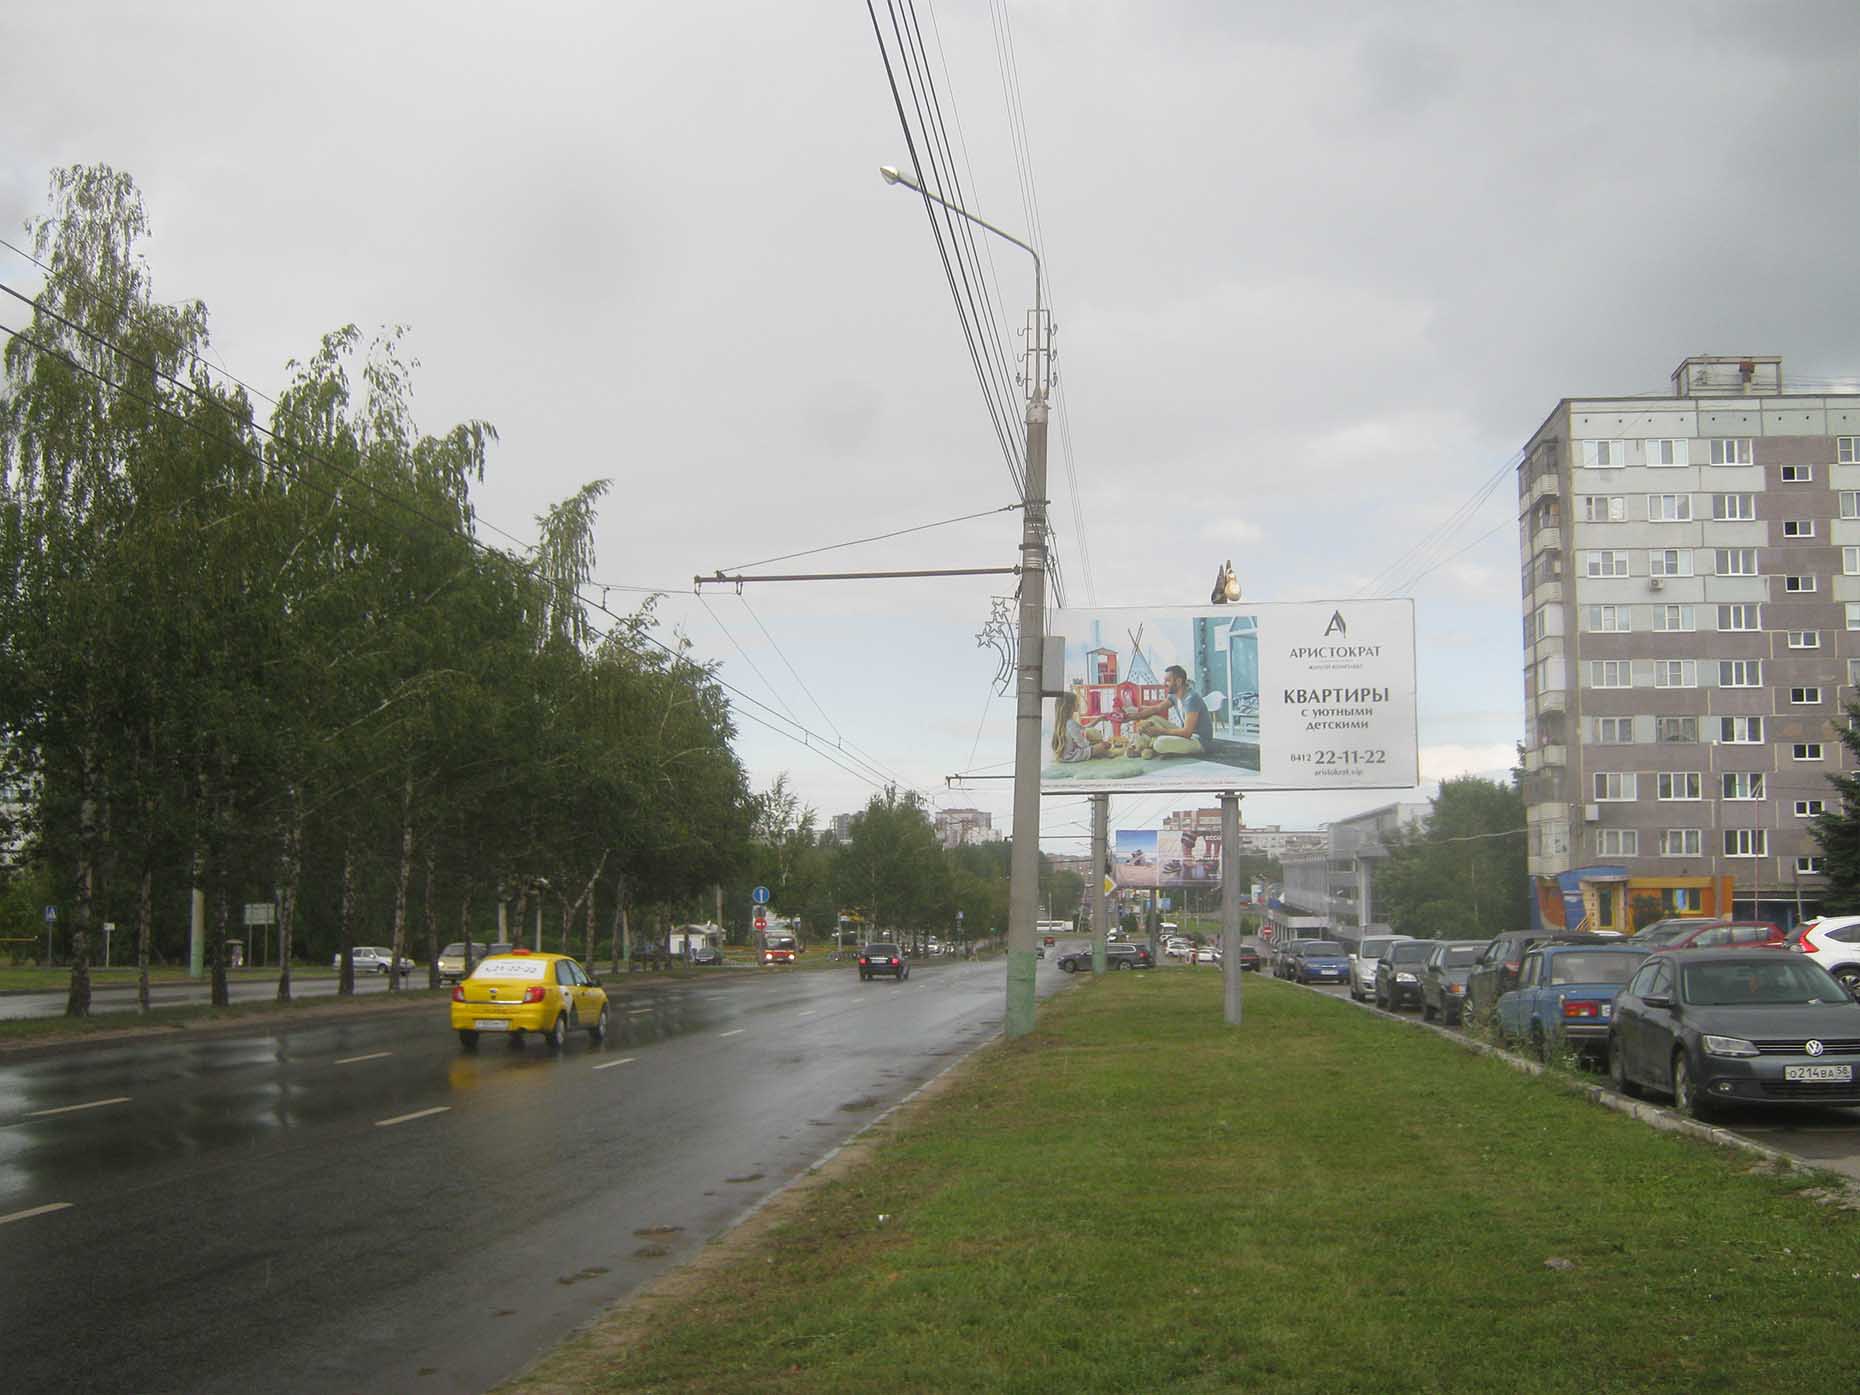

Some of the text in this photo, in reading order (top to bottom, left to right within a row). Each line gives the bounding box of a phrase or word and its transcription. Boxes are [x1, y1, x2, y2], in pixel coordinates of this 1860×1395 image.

[1289, 646, 1382, 659] АРИСТОКРАТ
[1284, 687, 1389, 704] КВАРТИРЫ
[1301, 707, 1373, 719] с уютными
[1305, 720, 1369, 731] детскими
[1314, 750, 1386, 765] 22-11-22
